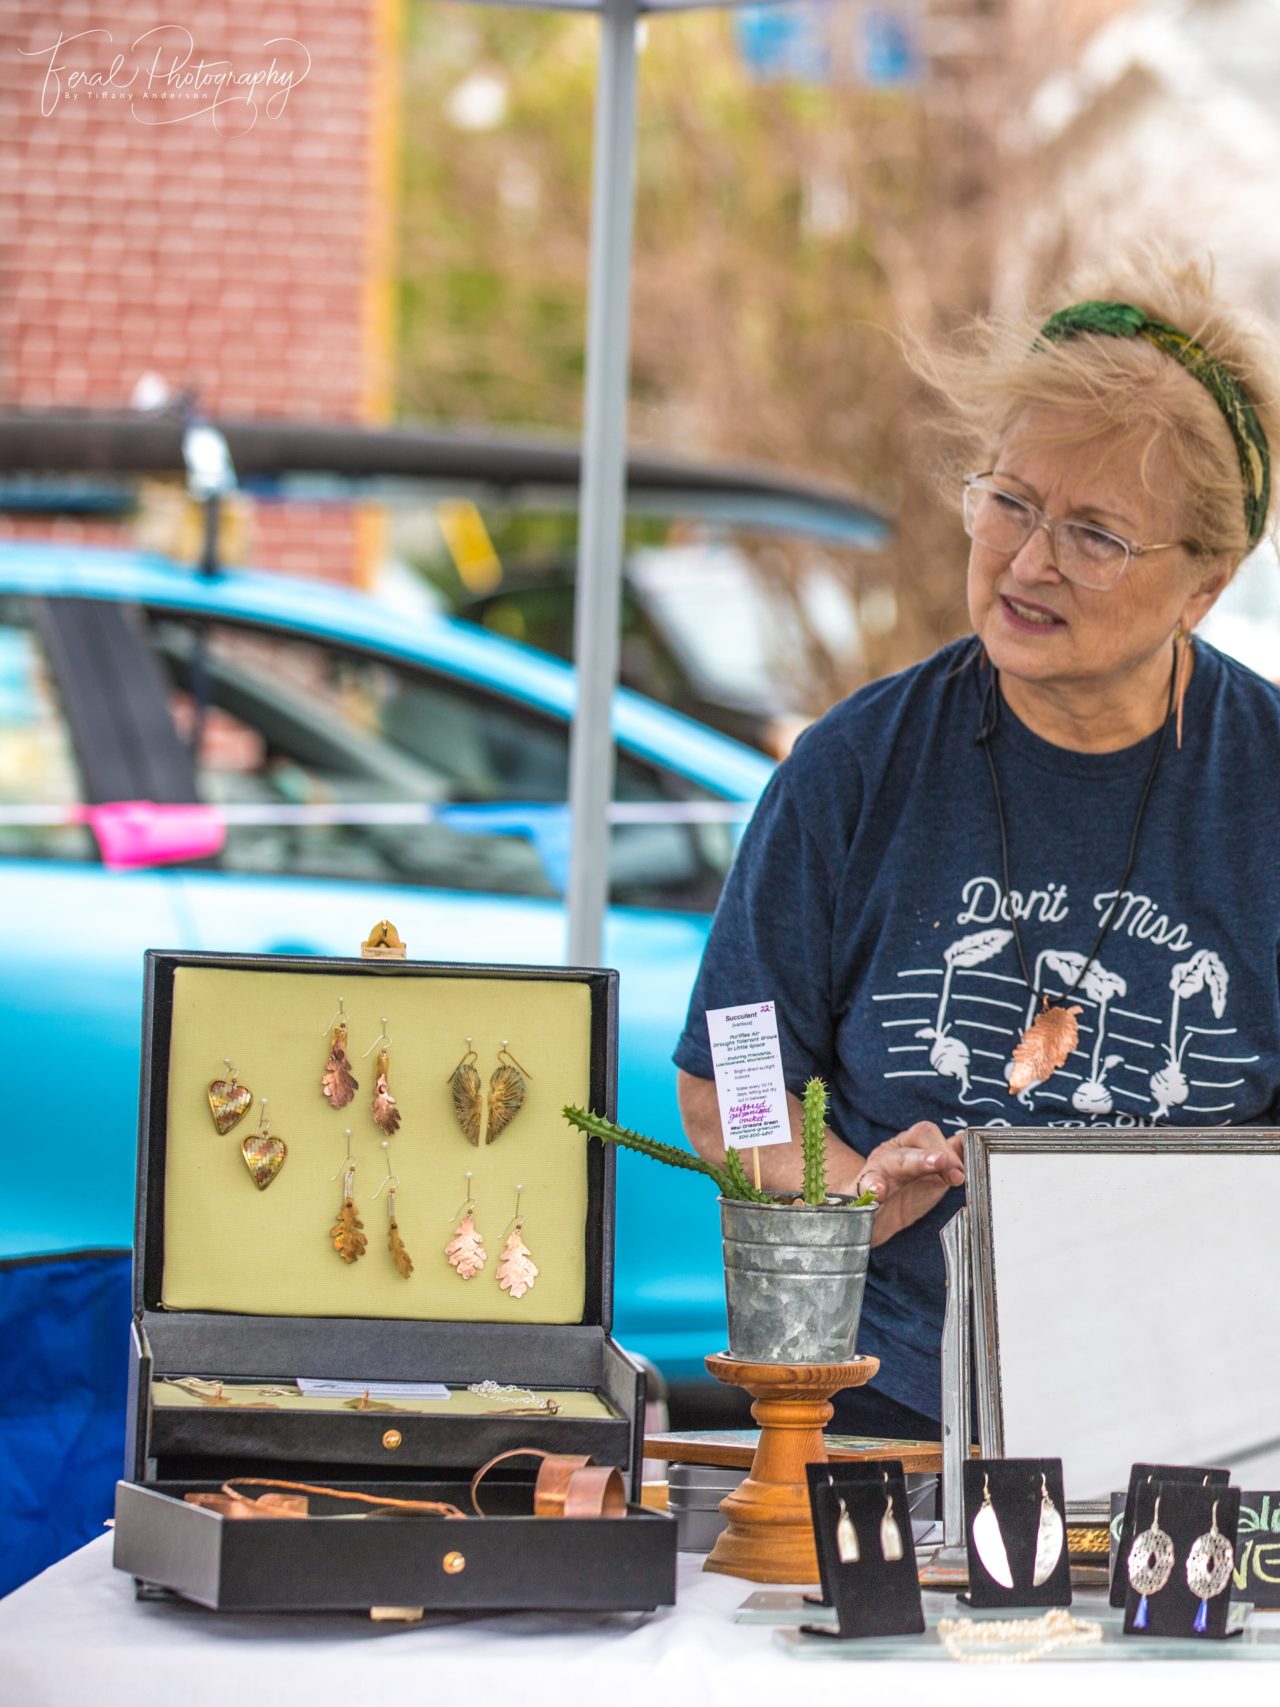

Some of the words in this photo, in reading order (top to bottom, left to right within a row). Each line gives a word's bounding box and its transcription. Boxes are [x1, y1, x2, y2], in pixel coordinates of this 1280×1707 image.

[957, 876, 1069, 925] Don't
[1093, 889, 1192, 952] Miss
[725, 1012, 757, 1021] Succulent
